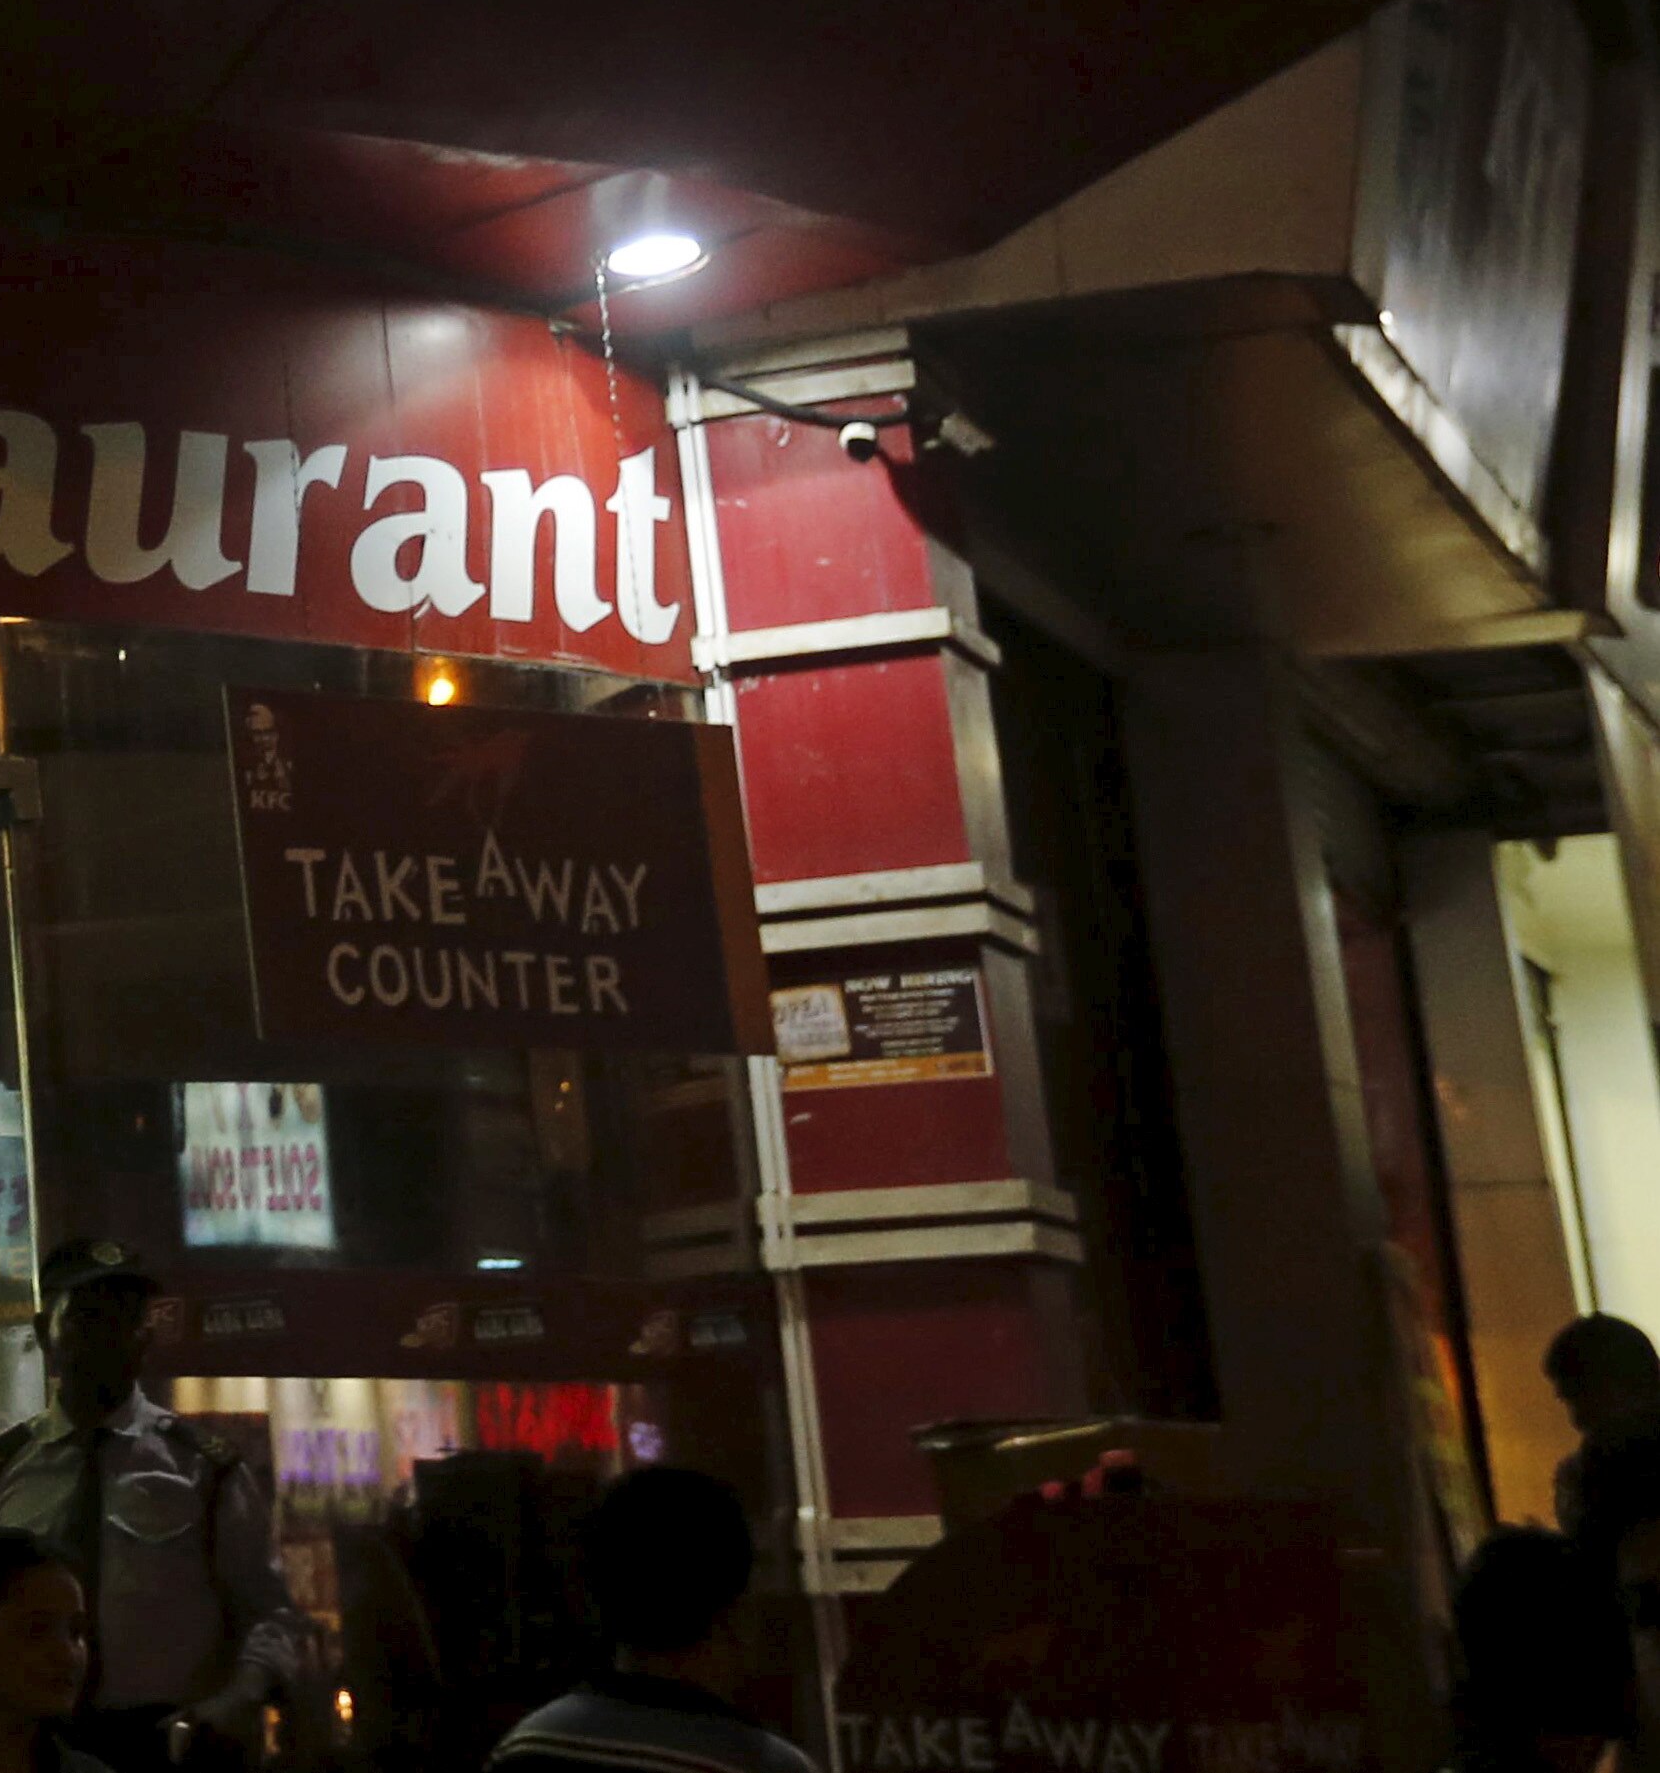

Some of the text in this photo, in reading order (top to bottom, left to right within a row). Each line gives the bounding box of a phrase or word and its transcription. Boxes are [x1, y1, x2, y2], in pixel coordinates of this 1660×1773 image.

[250, 790, 292, 812] KFC
[285, 829, 648, 934] TAKE AWAY
[326, 941, 630, 1015] COUNTER
[835, 1689, 1174, 1773] TAKE AWAY
